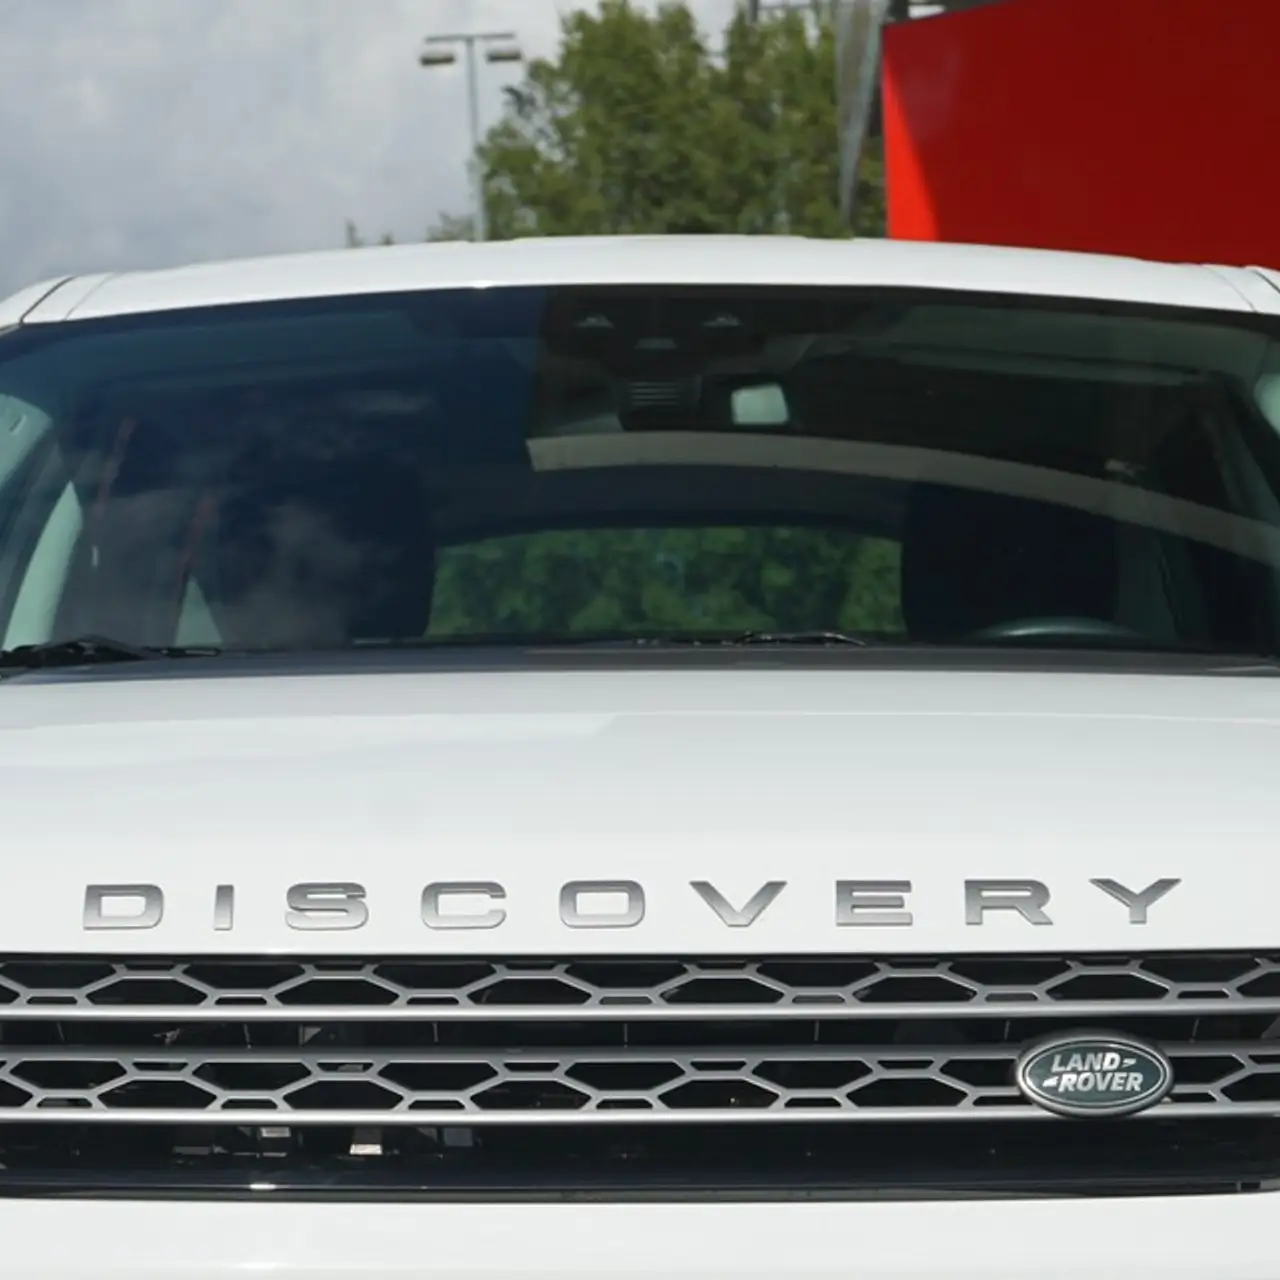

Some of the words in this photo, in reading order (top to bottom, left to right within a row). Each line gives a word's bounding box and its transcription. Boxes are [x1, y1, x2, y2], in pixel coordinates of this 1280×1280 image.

[82, 877, 1182, 932] DISCOVERY
[1051, 1052, 1121, 1073] LAND
[1057, 1072, 1144, 1093] ROVER
